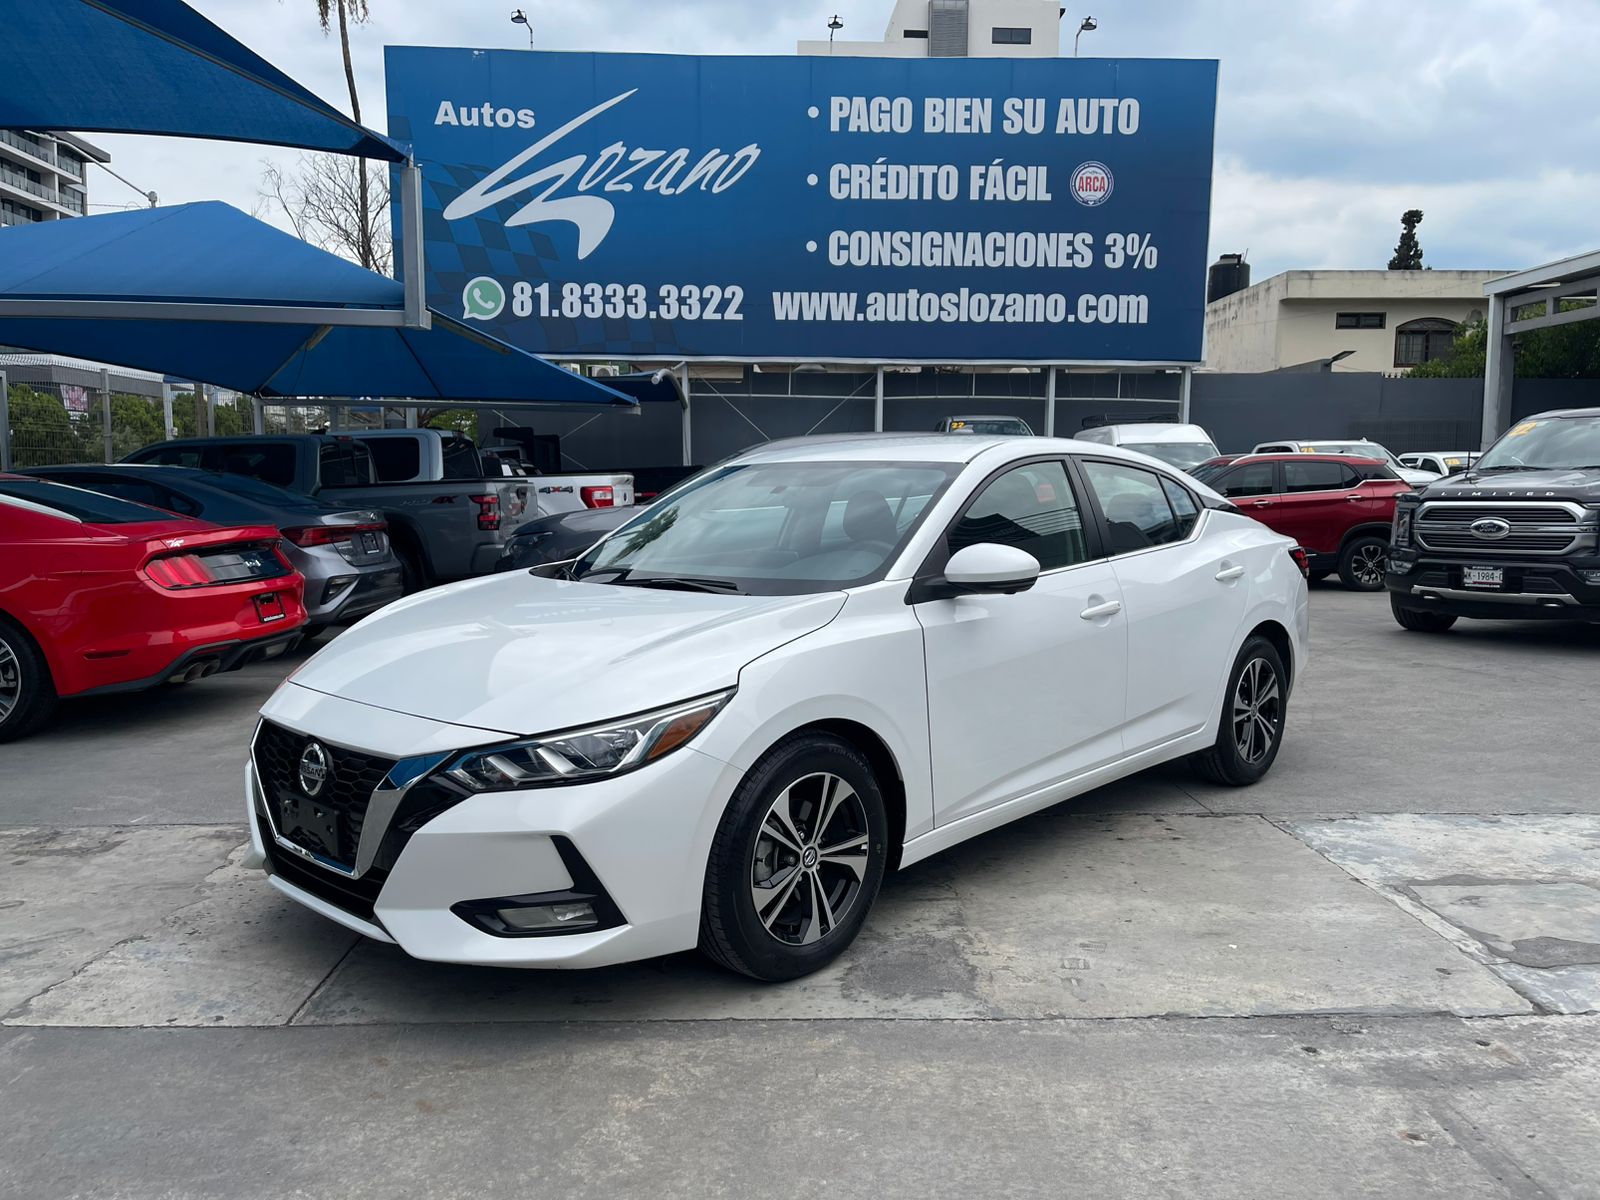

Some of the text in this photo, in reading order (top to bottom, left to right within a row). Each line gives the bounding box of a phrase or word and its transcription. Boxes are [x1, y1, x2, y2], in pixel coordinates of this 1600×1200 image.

[434, 101, 536, 128] Autos
[830, 96, 1140, 135] PAGO BIEN SU AUTO
[443, 88, 761, 260] Lozano
[829, 157, 1052, 201] CRÉDITO FÁCIL
[1078, 176, 1105, 192] ARCA
[828, 230, 1158, 269] CONSIGNACIONES 3%
[512, 281, 744, 321] 81.8333.3322
[772, 287, 1149, 324] www.autoslozano.com
